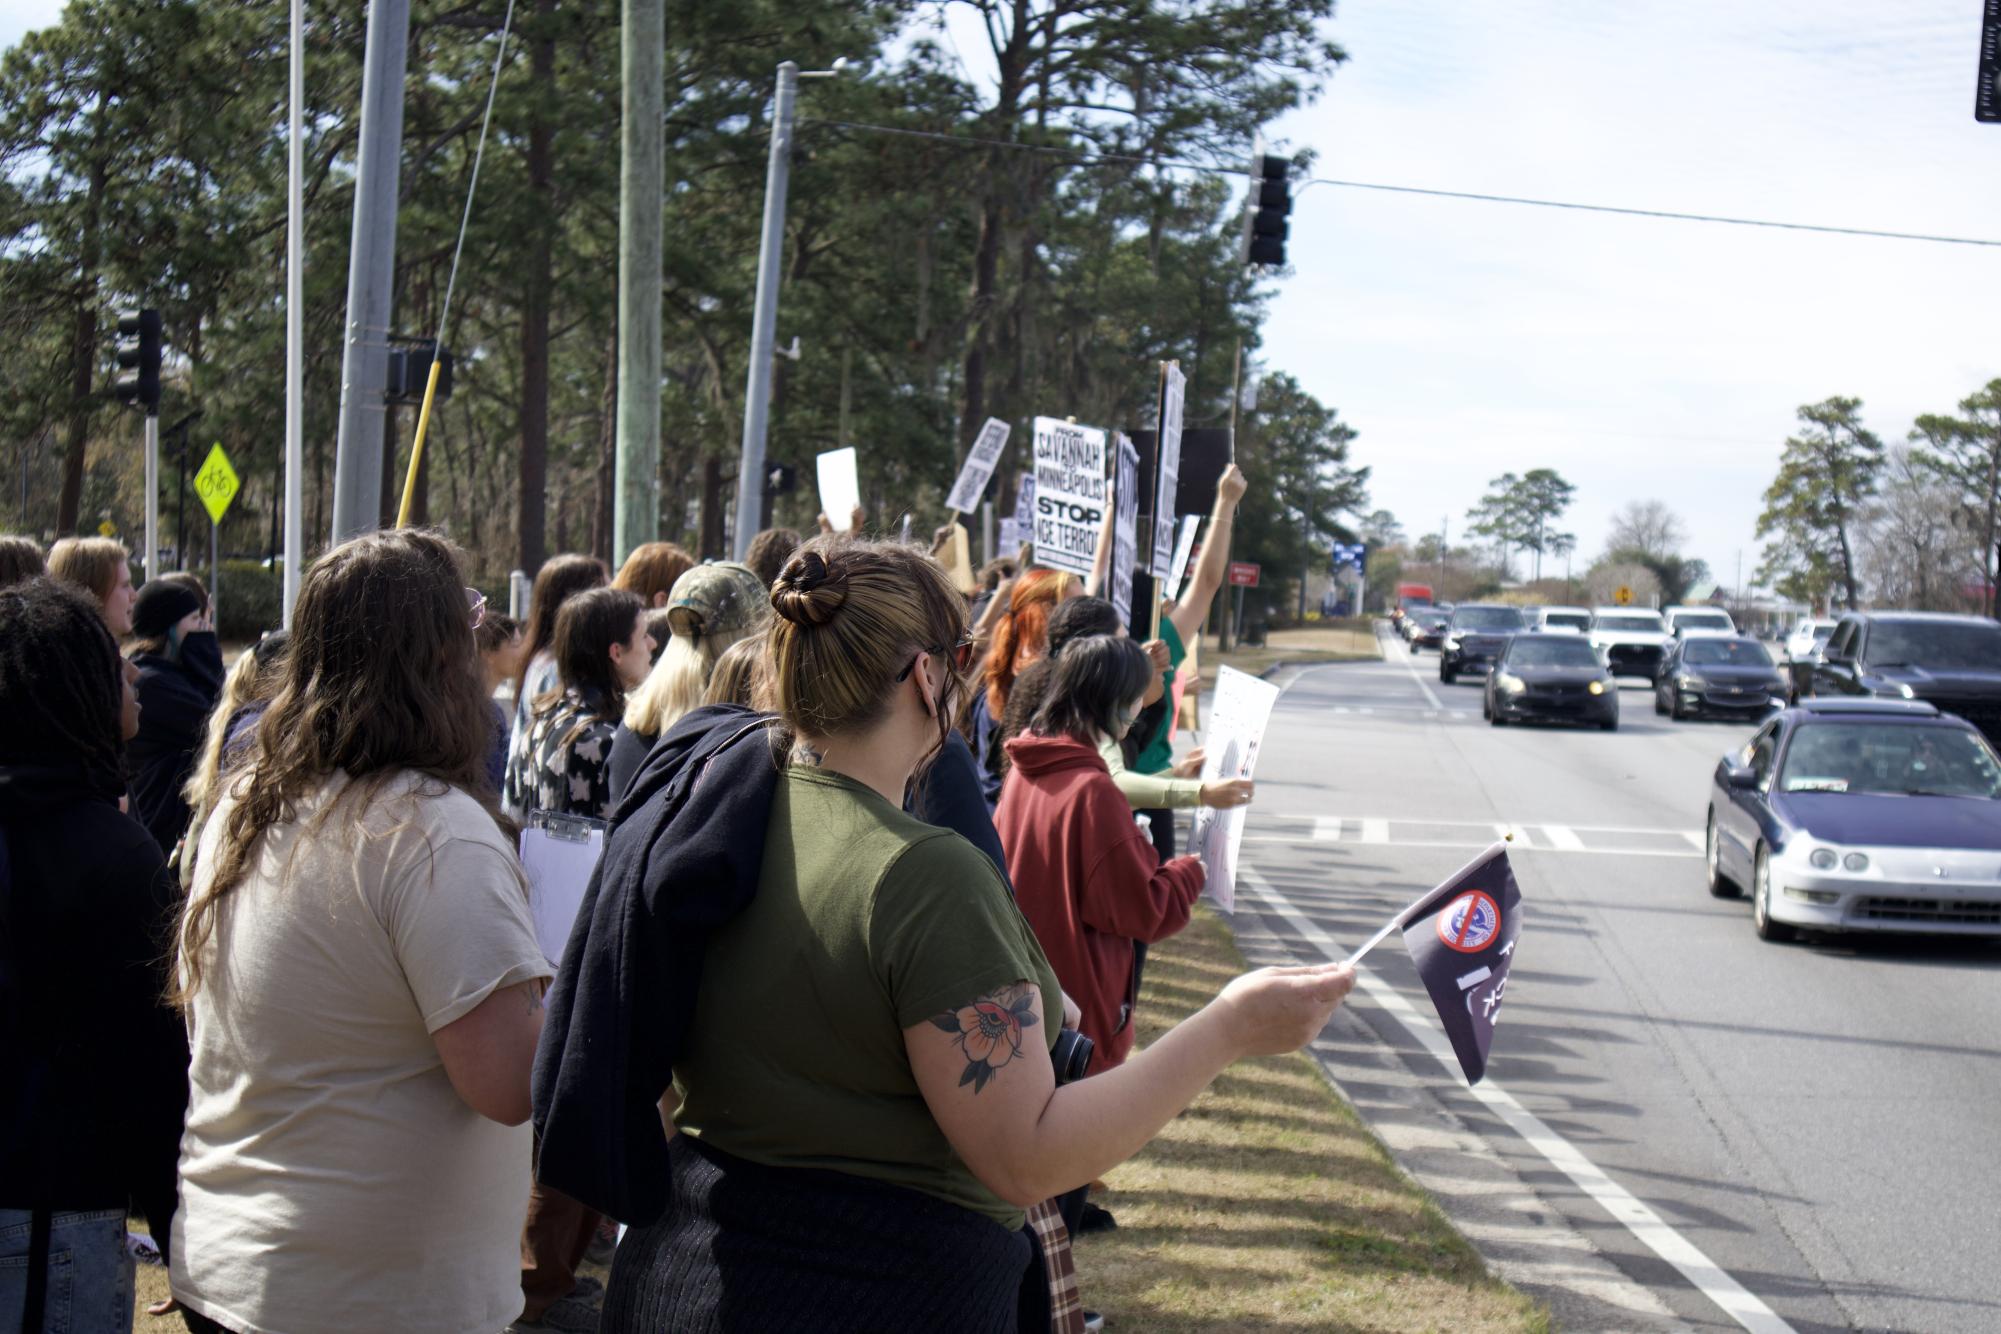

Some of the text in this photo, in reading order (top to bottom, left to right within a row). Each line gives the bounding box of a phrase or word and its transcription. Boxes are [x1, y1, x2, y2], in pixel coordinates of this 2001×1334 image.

[1055, 427, 1084, 438] FROM
[1038, 432, 1100, 472] SAVANNAH
[1038, 465, 1103, 499] MINNEAPOLIS
[1062, 463, 1076, 473] TO
[1038, 496, 1102, 525] STOP
[1037, 518, 1055, 545] ICE
[1057, 522, 1099, 555] TERRO
